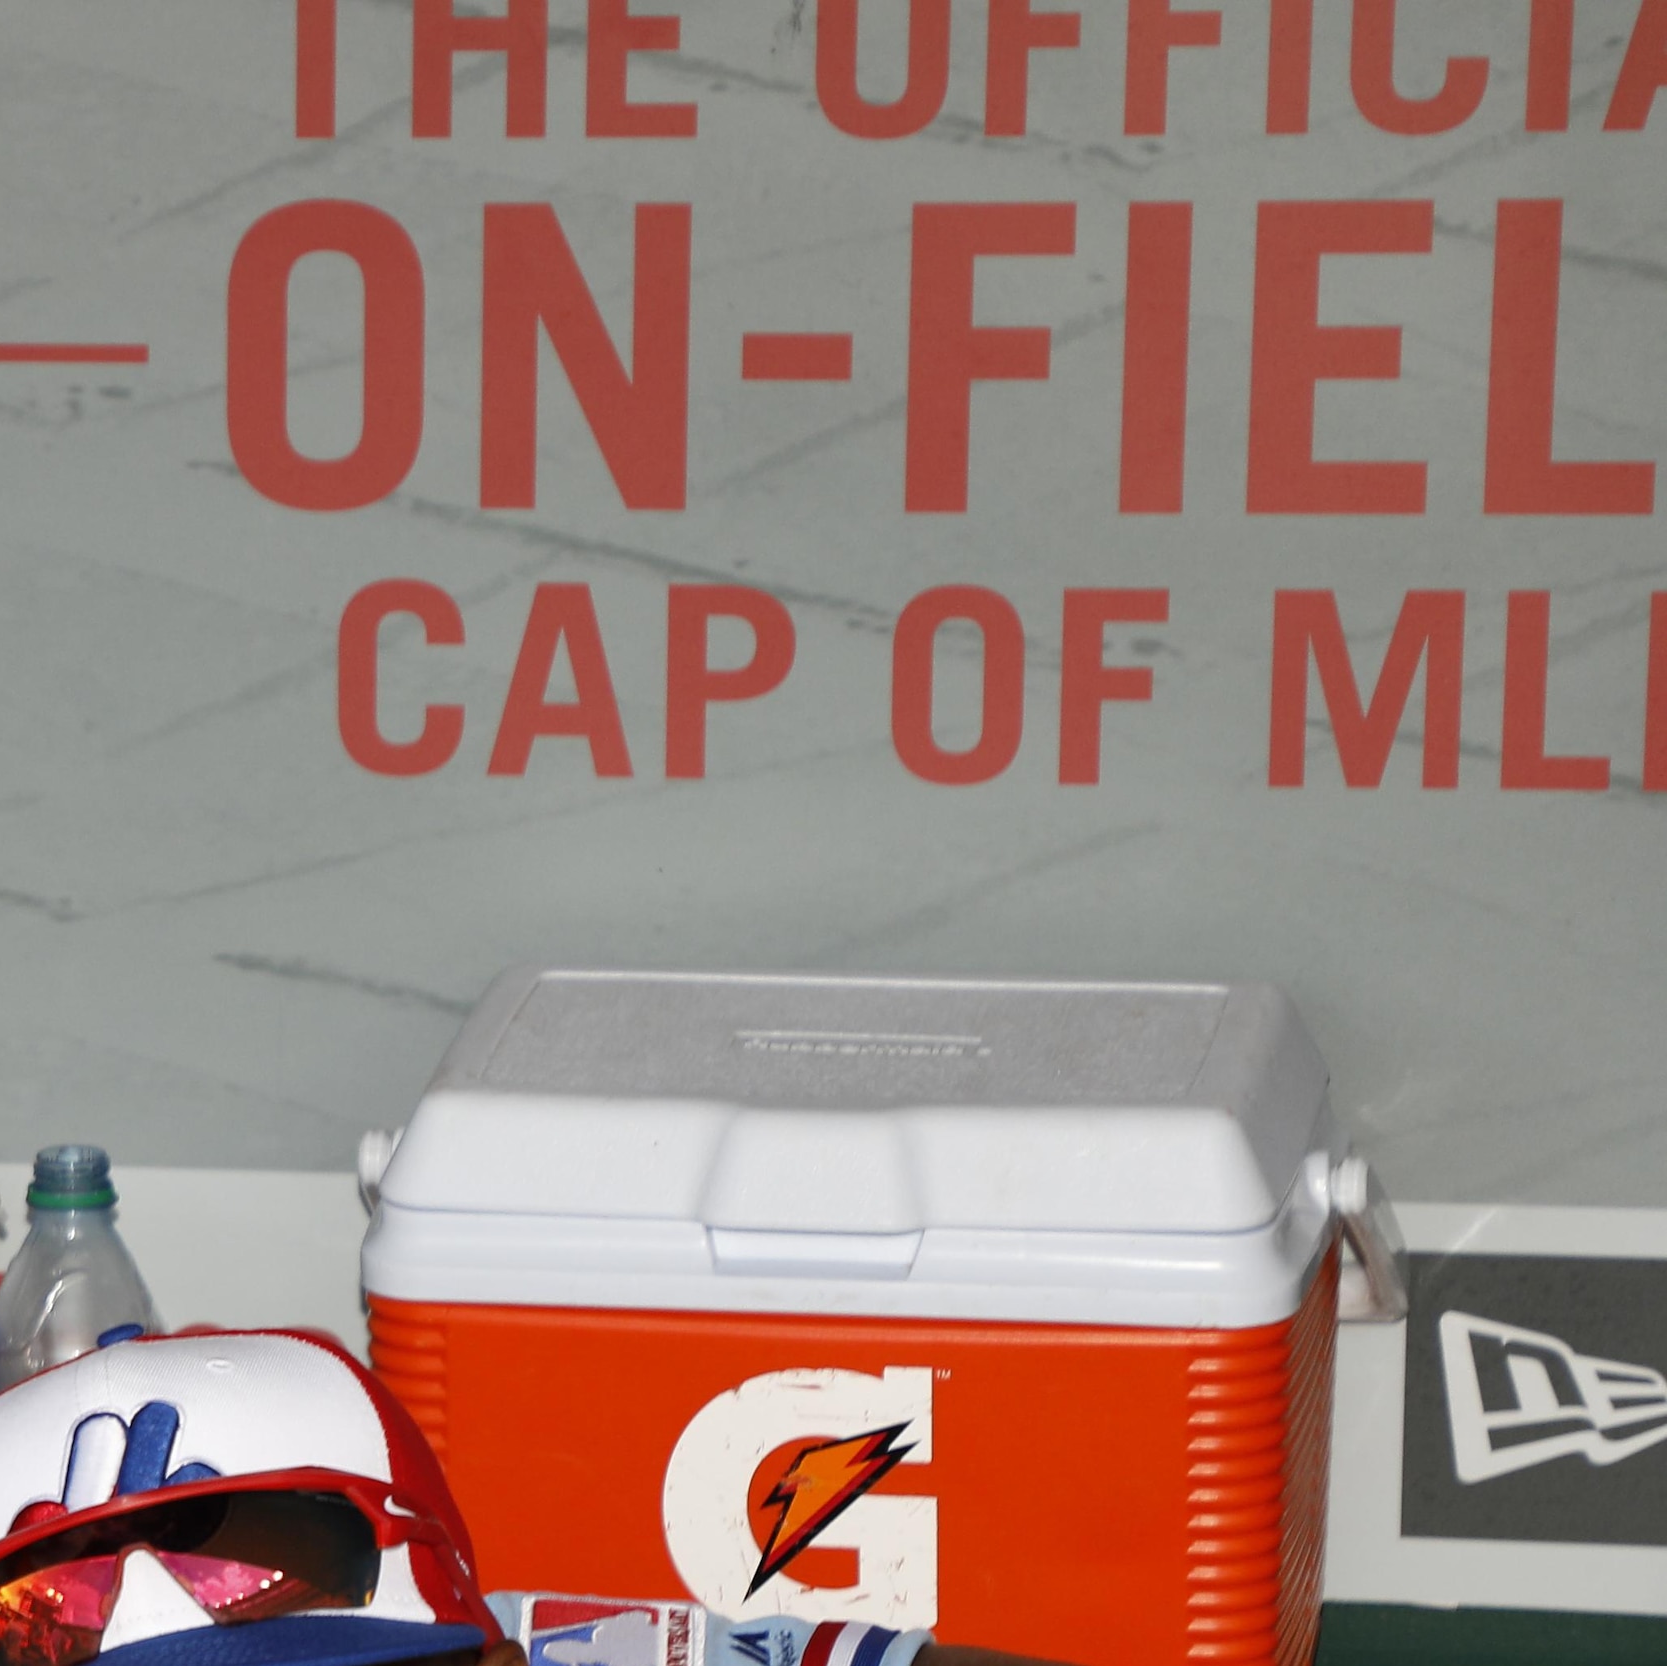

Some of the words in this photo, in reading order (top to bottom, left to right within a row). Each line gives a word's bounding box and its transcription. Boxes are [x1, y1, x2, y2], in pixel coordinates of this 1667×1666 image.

[296, 0, 697, 139] THE
[226, 198, 1657, 515] ON-FIEL
[337, 578, 797, 779] CAP
[890, 585, 1170, 786] OF
[1267, 589, 1667, 792] ML
